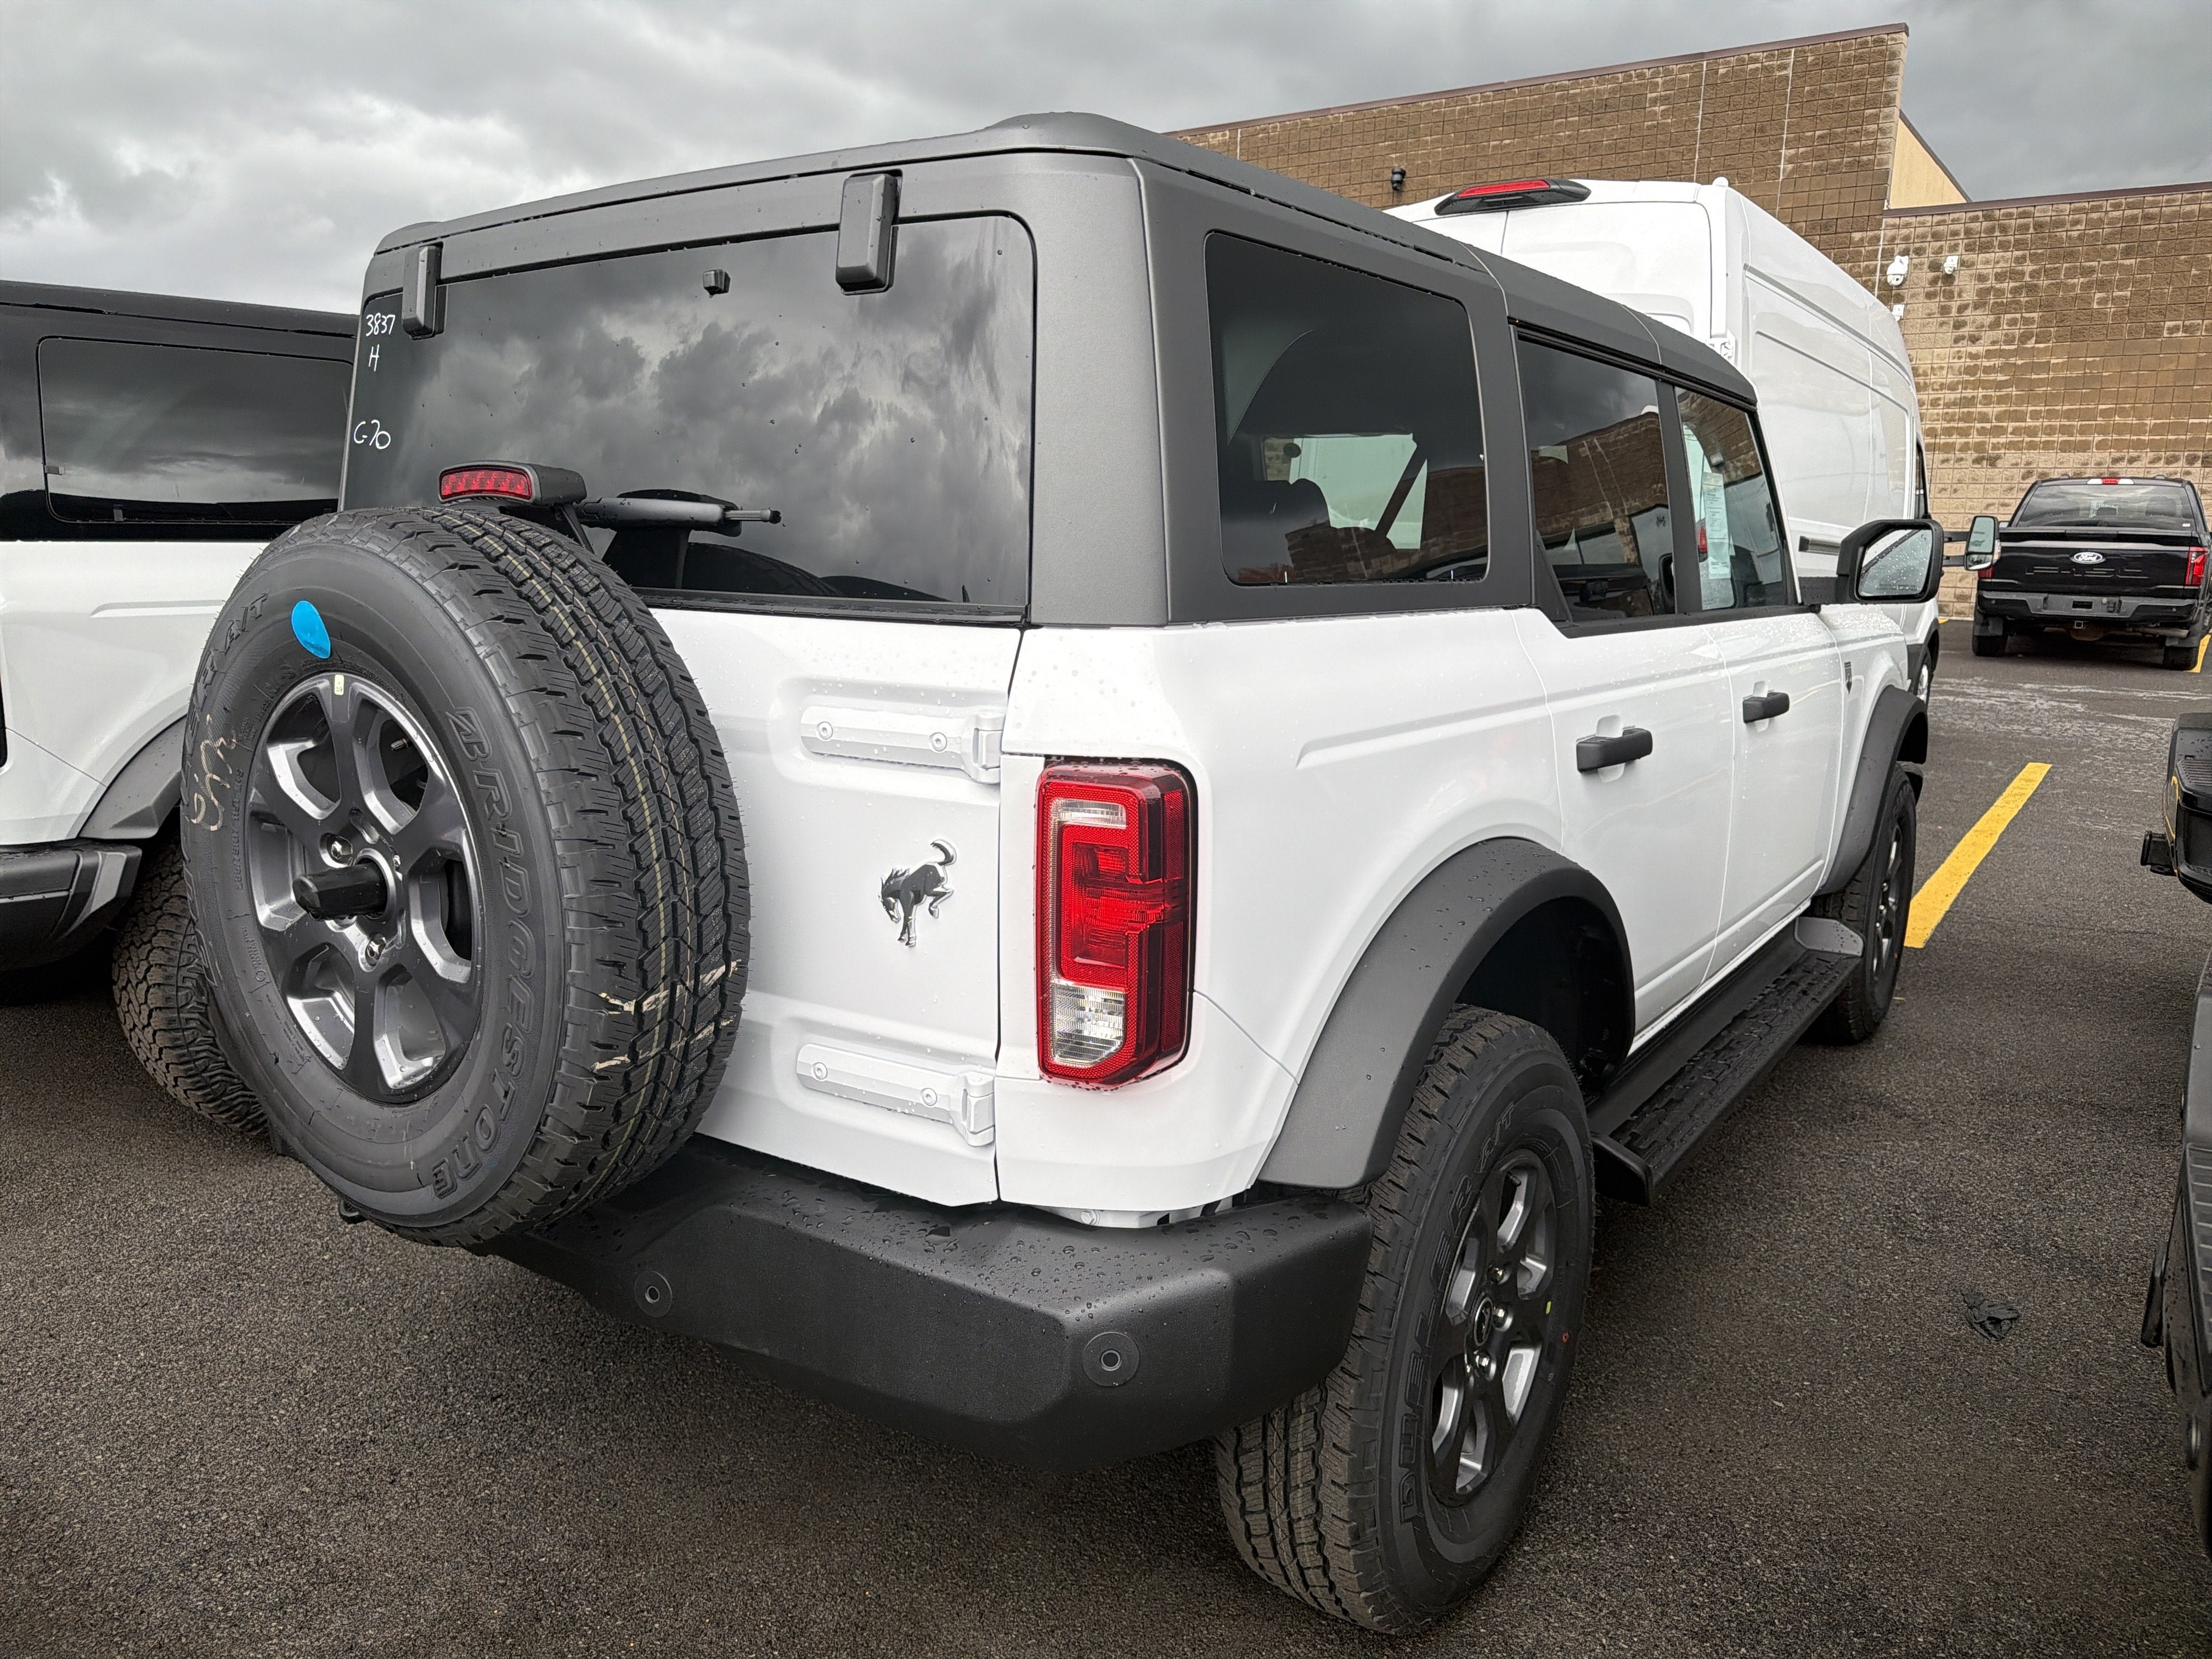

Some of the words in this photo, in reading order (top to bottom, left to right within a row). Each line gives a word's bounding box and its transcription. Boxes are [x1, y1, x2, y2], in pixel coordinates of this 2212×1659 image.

[366, 312, 396, 337] 3837
[369, 344, 380, 372] H
[432, 707, 534, 1199] BRIDGESTONE
